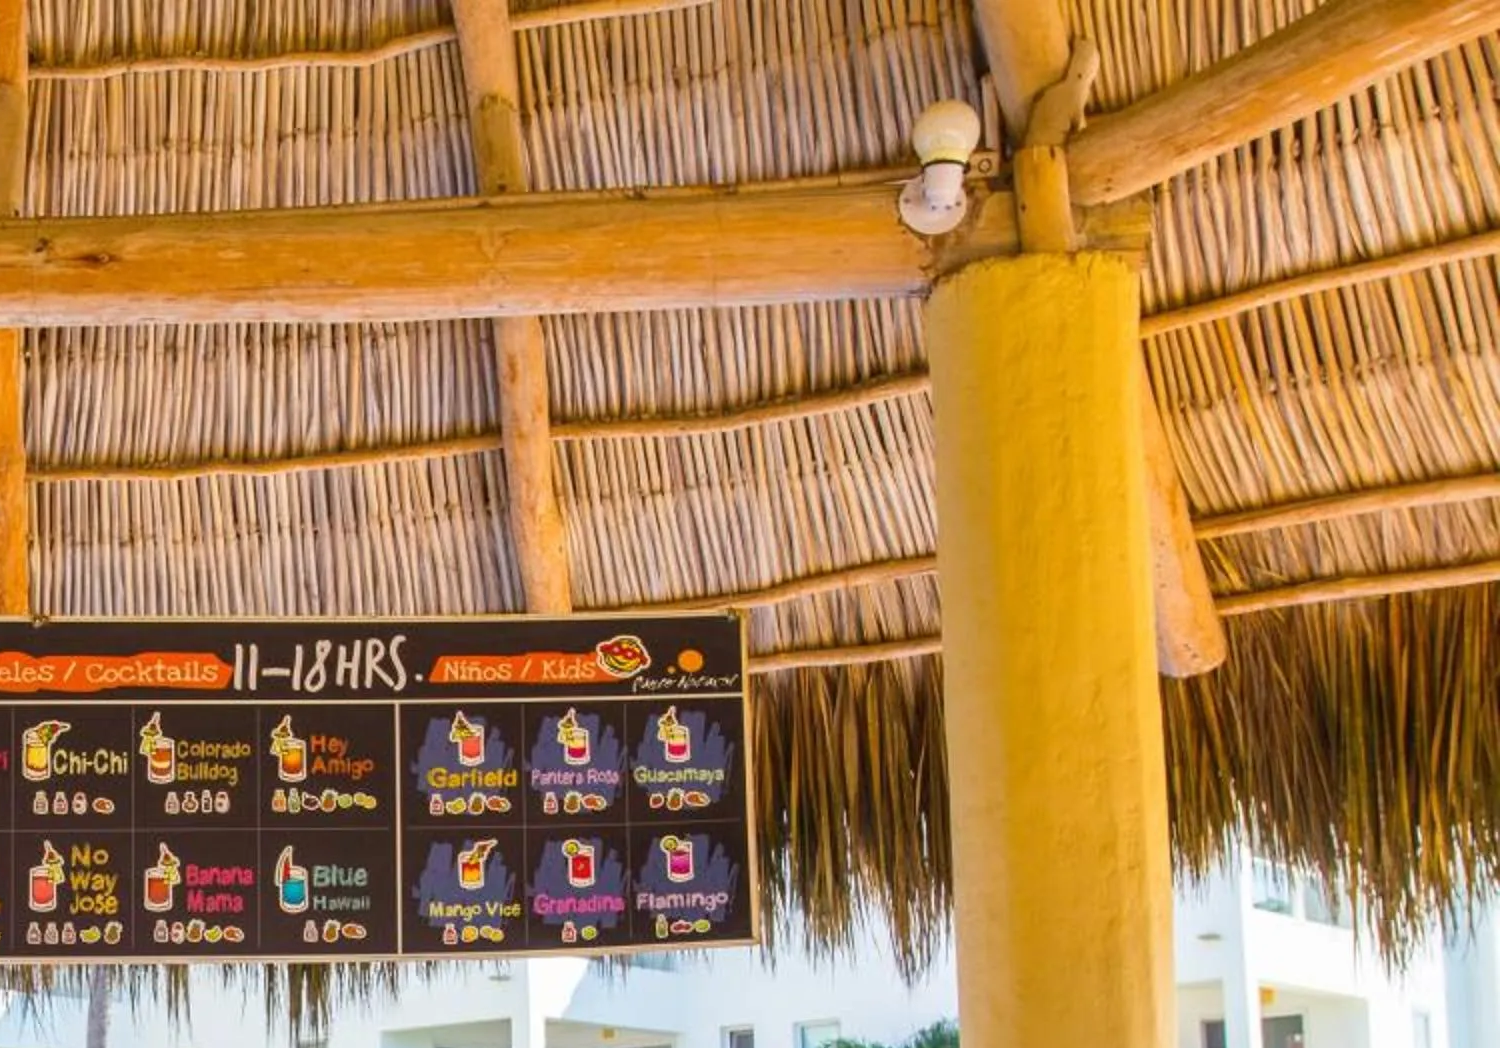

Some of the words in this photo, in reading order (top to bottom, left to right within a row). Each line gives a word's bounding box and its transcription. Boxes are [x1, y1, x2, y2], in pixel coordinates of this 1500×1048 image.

[85, 656, 220, 684] Cocktails
[443, 660, 512, 682] Niños
[541, 658, 597, 680] Kids
[176, 739, 251, 758] Colorado
[310, 734, 349, 759] Hey
[53, 749, 129, 776] Chi-Chi
[176, 761, 238, 785] Bulldog
[310, 756, 375, 781] Amigo
[427, 767, 518, 789] Garfield
[633, 766, 725, 785] Guacamaya
[70, 844, 109, 868] No
[69, 871, 118, 897] Way
[185, 863, 255, 886] Banana
[313, 864, 369, 888] Blue
[186, 889, 244, 913] Mama
[313, 895, 371, 912] Hawaii
[429, 902, 482, 922] Mango
[636, 891, 730, 912] Flamingo
